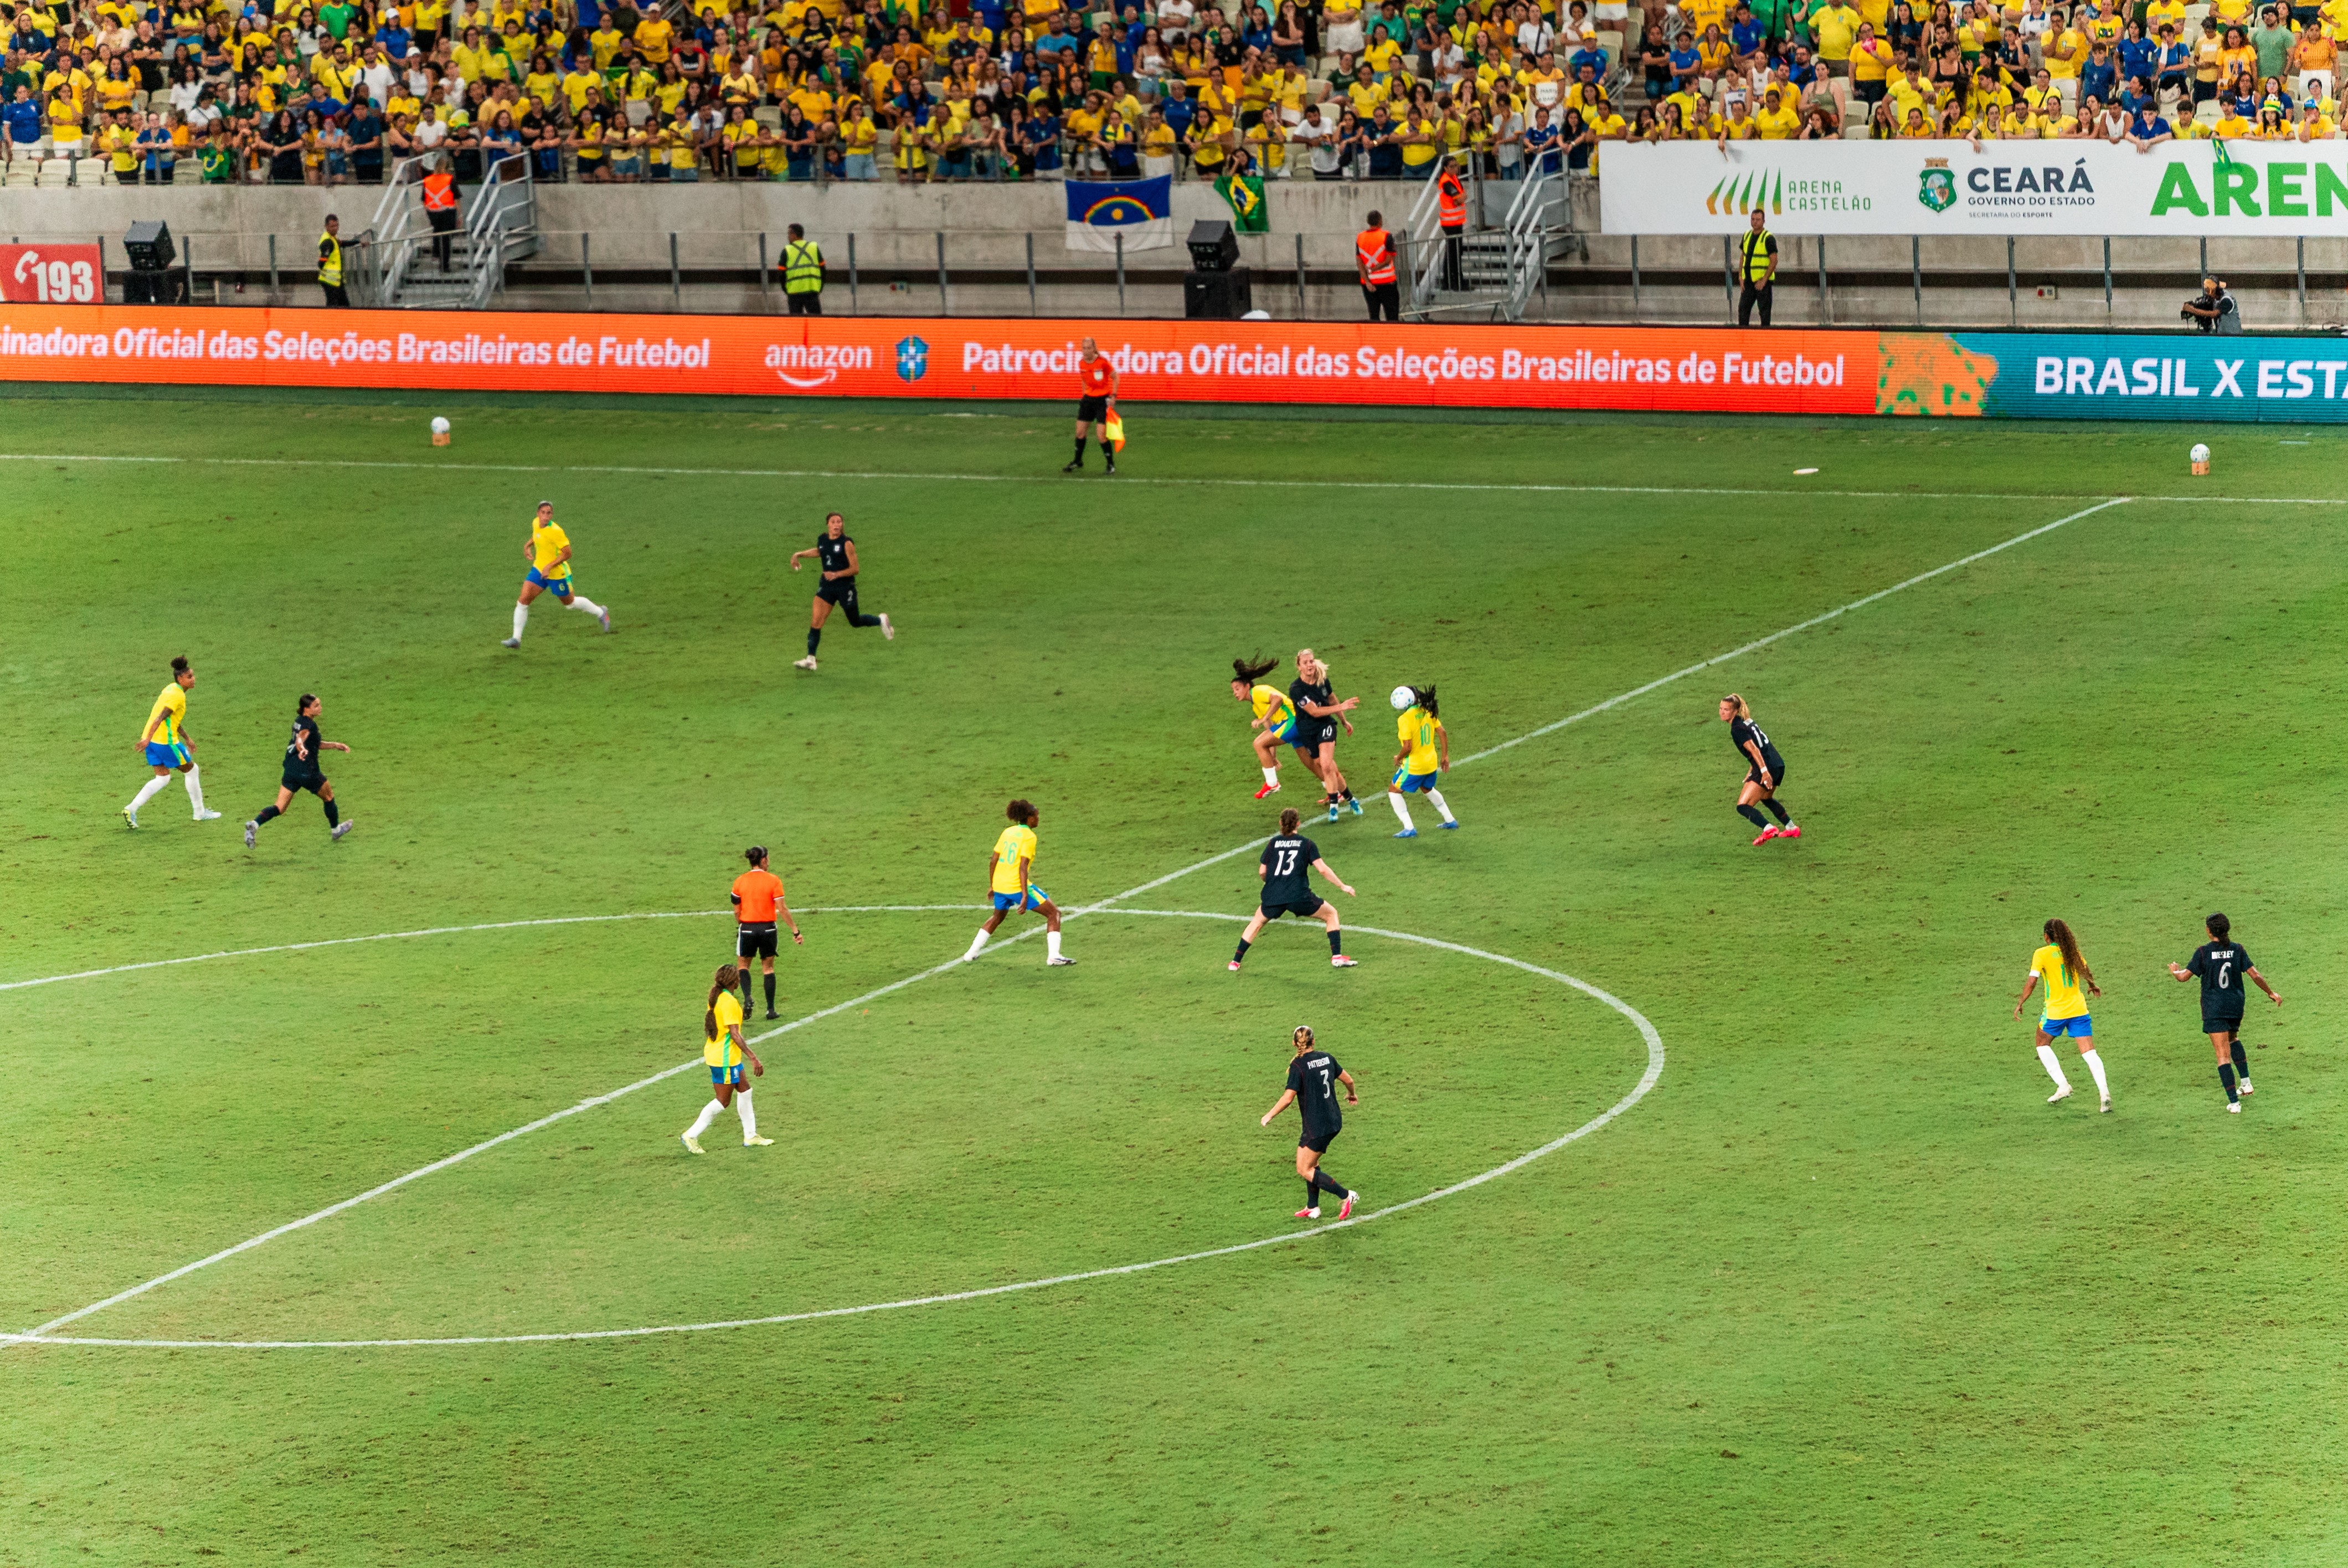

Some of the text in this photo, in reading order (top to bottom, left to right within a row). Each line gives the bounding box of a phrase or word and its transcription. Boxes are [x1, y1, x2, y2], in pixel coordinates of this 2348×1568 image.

[1789, 181, 1841, 193] ARENA
[1968, 157, 2094, 193] CEARÁ
[1789, 194, 1871, 210] CASTELÃO
[1968, 197, 2025, 205] GOVERNO
[2150, 162, 2348, 217] AREN
[31, 261, 94, 302] 193
[114, 327, 204, 358] Oficial
[209, 330, 258, 359] das
[264, 329, 392, 367] Seleções
[397, 333, 552, 364] Brasileiras
[557, 337, 593, 365] de
[599, 337, 709, 368] Futebol
[765, 344, 872, 368] amazon
[963, 342, 1844, 386] Patrocidora Oficial das Seleções Brasileiras de Futebol
[2036, 357, 2348, 398] BRASIL X EST
[1322, 725, 1332, 737] 10
[1420, 723, 1430, 746] 10
[998, 841, 1017, 865] 26
[1274, 850, 1298, 876] 13
[2218, 962, 2231, 989] 6
[1320, 1069, 1330, 1099] 3
